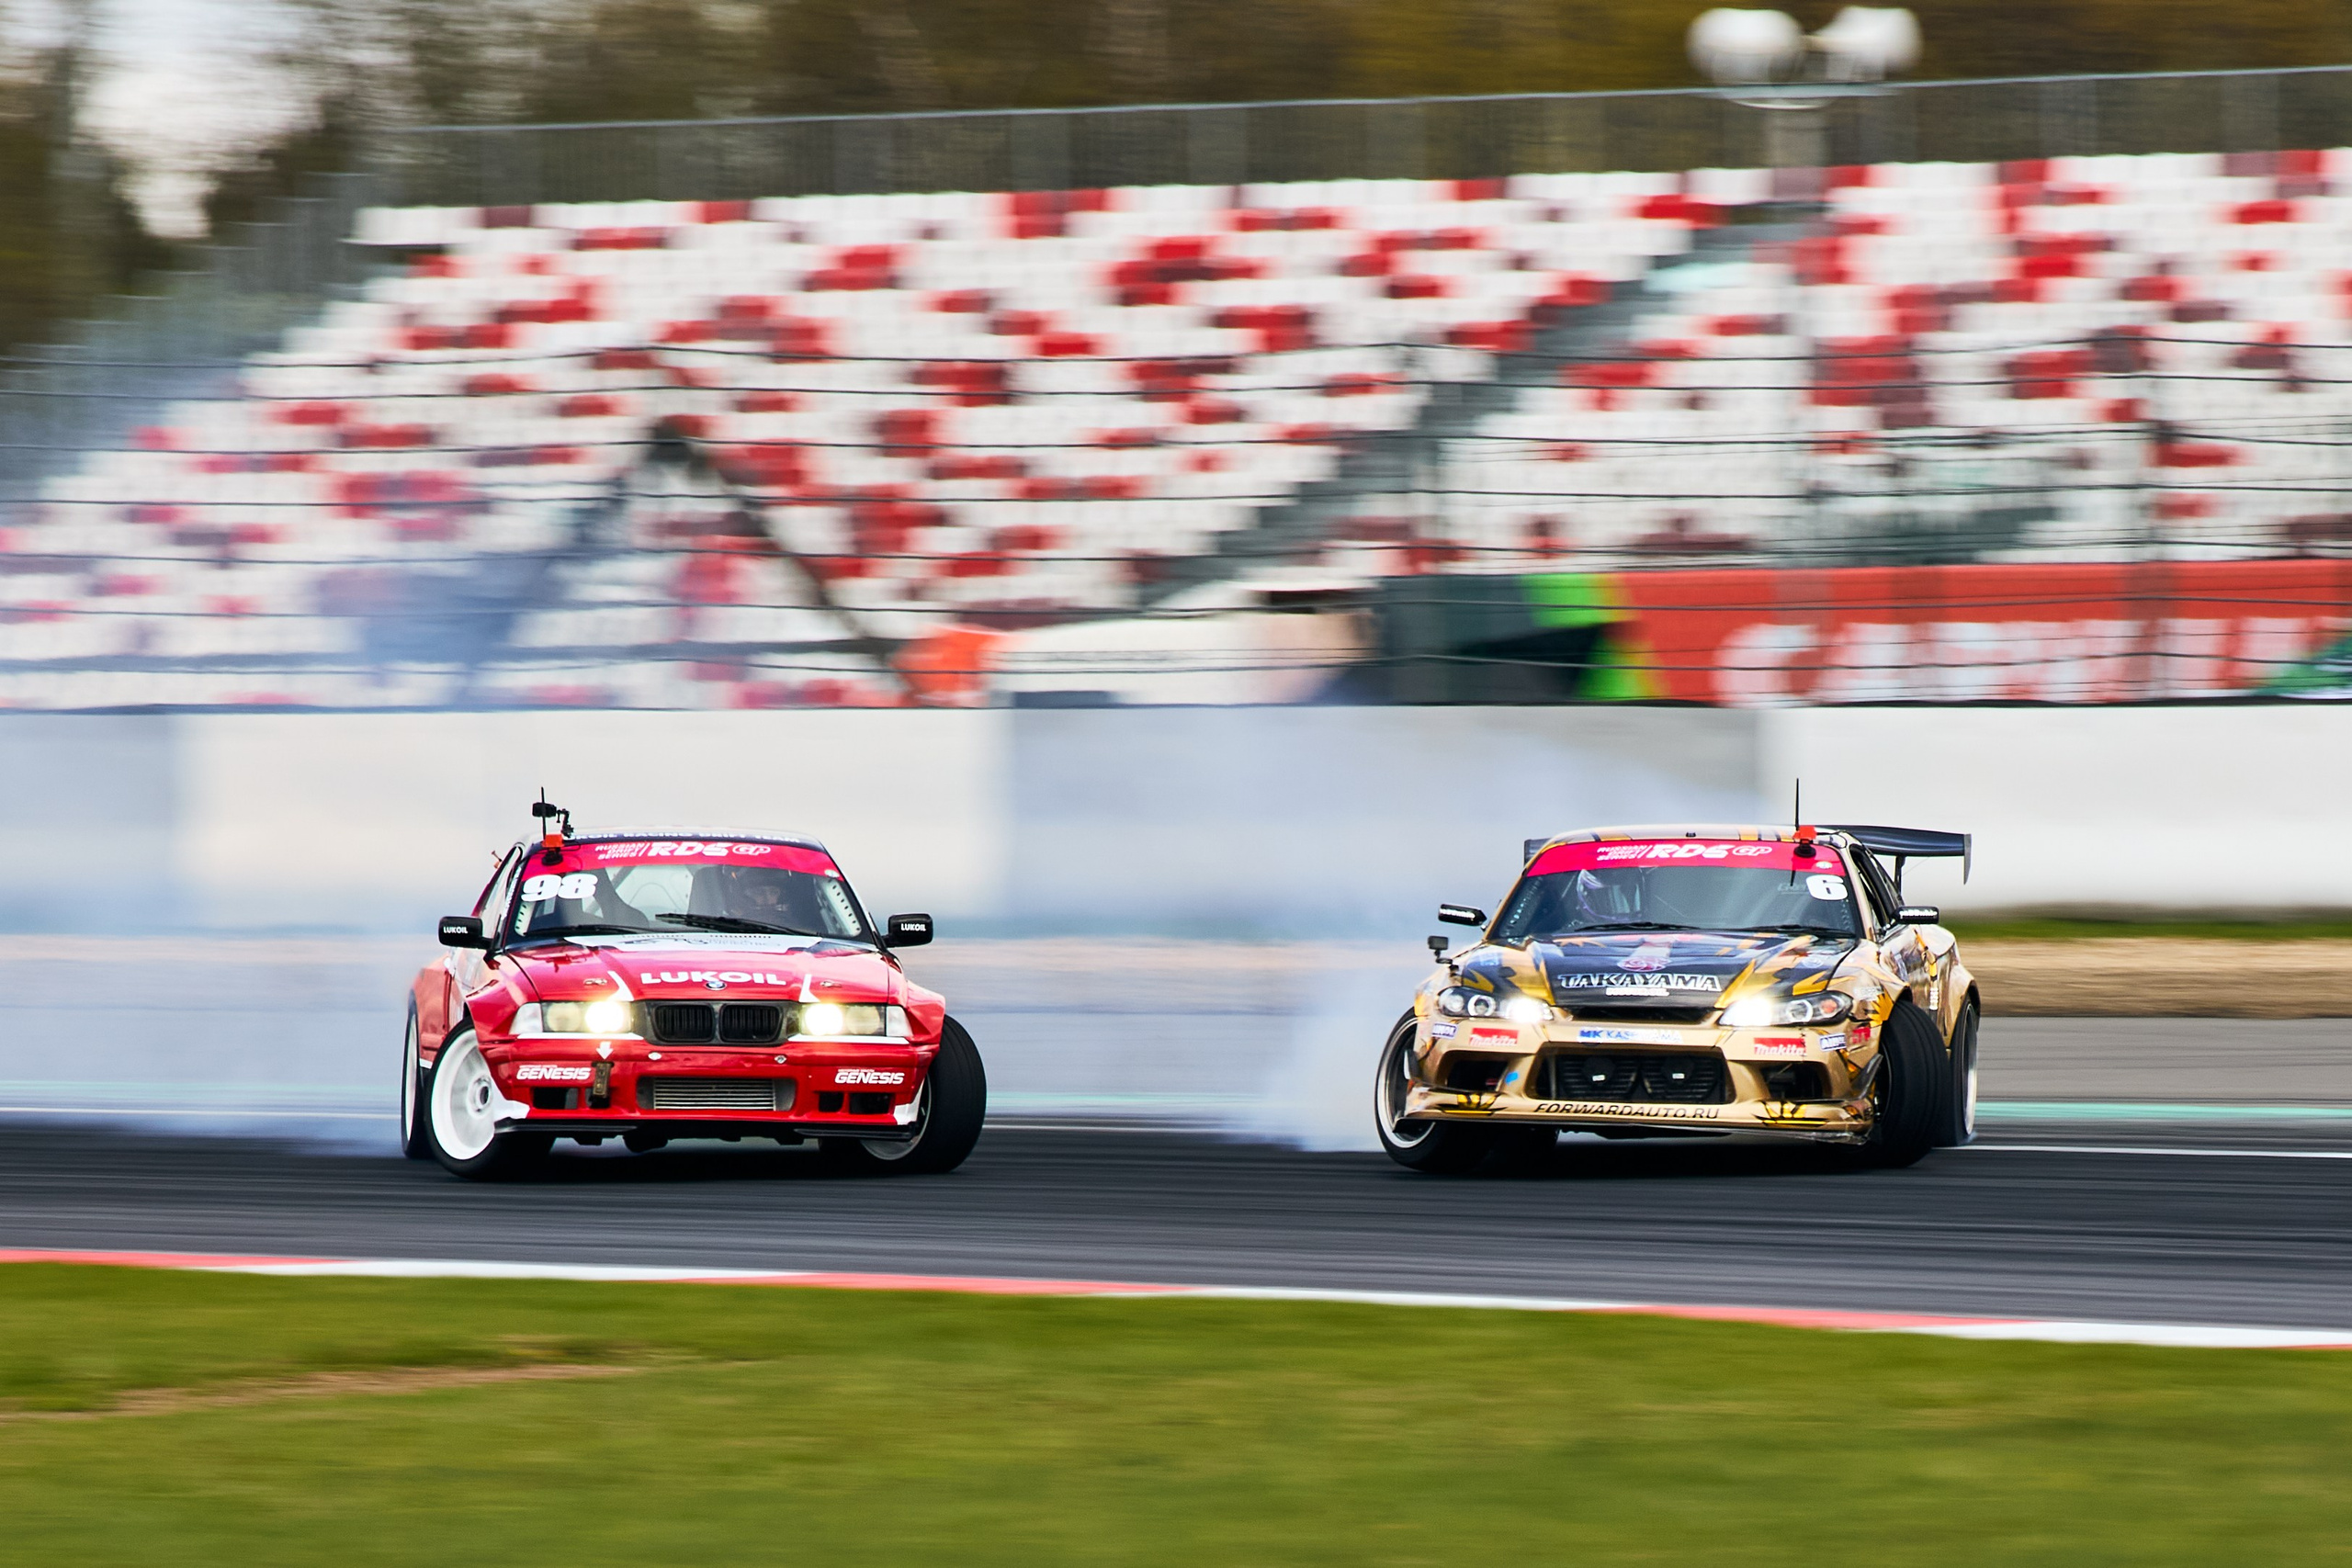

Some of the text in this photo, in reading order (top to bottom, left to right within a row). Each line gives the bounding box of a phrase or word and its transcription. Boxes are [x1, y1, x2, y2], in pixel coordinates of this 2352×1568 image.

[595, 842, 645, 852] RUSSIAN
[648, 841, 771, 857] RDS GP
[1646, 844, 1773, 859] RDS GP
[598, 851, 638, 861] SERIES
[521, 874, 598, 901] 98
[1805, 874, 1848, 900] 6
[443, 926, 469, 934] LUKOIL
[900, 923, 926, 931] LUKOIL
[640, 970, 786, 987] LUKOIL
[1557, 973, 1723, 992] TAKAYAMA
[1579, 1029, 1604, 1039] MK
[516, 1067, 591, 1080] GENESIS
[834, 1072, 905, 1084] GENESIS
[1532, 1102, 1720, 1119] FORWARDAUTO.RU
